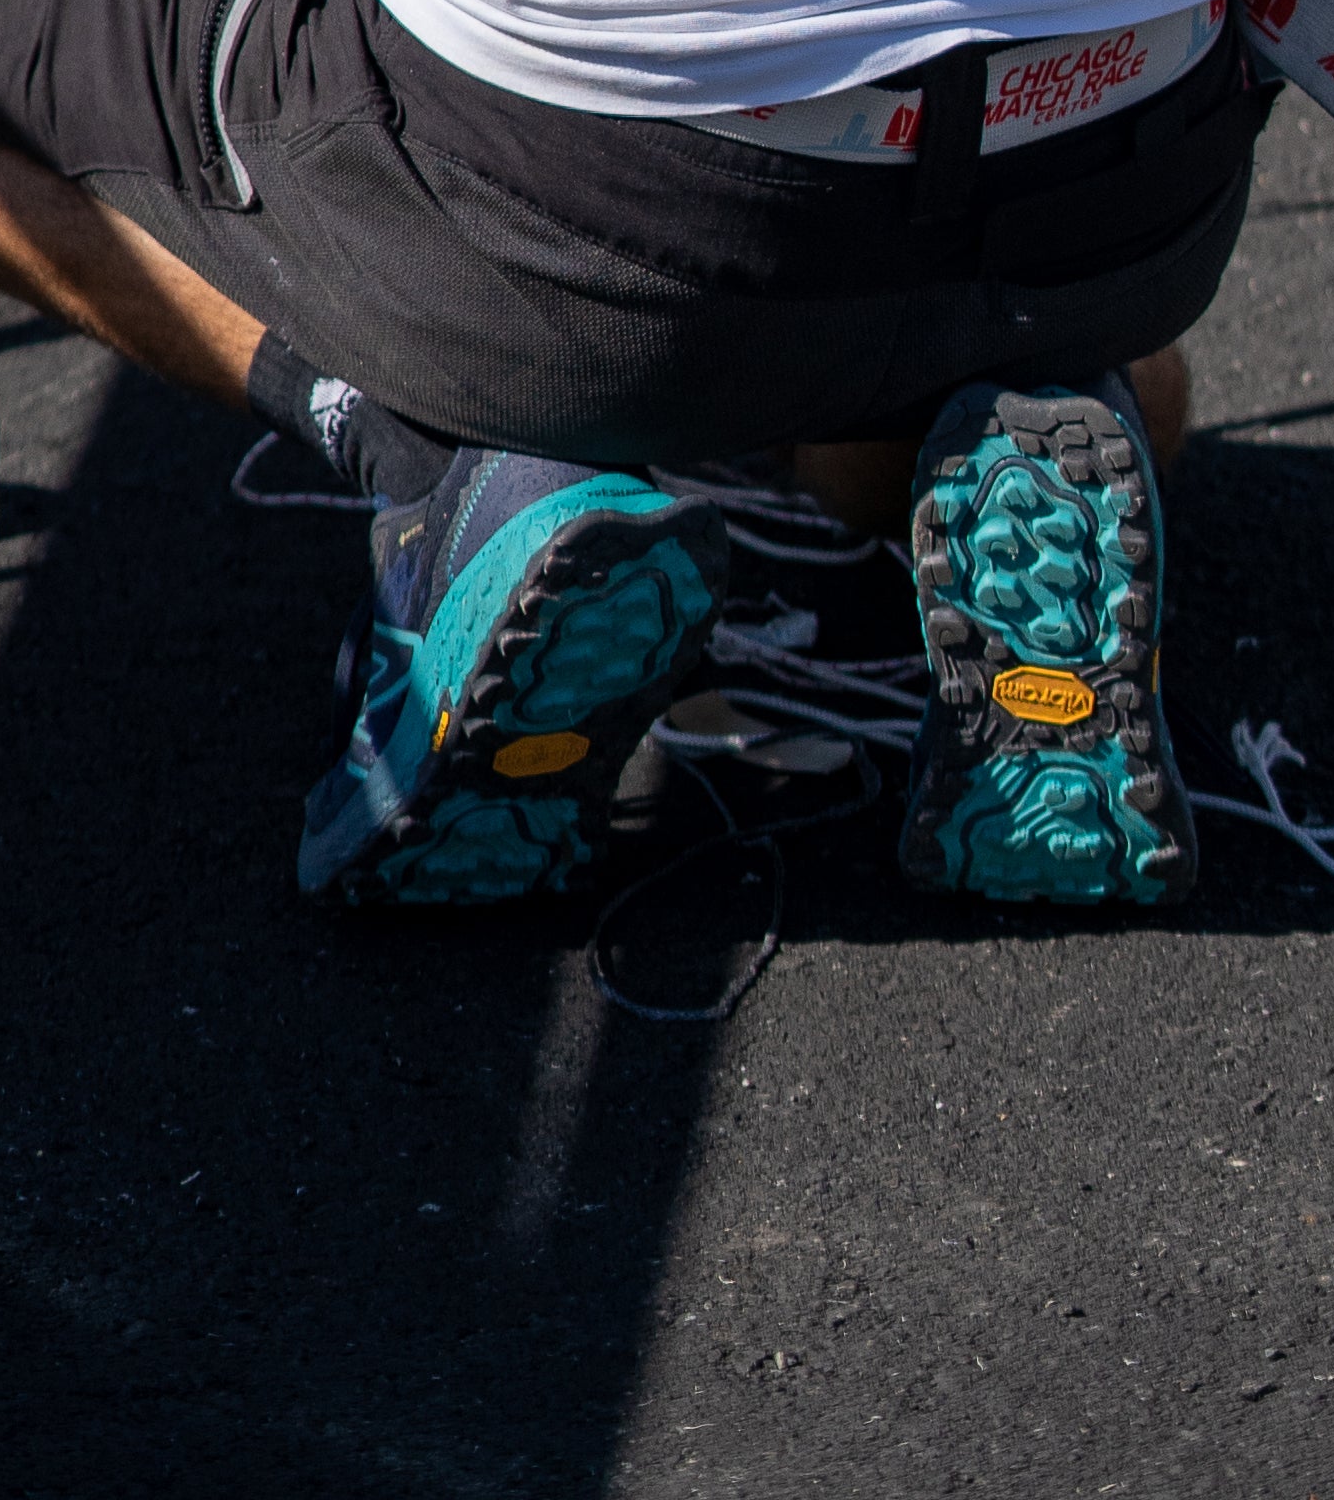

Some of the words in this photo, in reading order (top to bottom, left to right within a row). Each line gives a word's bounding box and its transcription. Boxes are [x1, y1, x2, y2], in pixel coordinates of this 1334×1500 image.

[984, 79, 1075, 127] MATCH
[1080, 48, 1148, 99] RACE
[999, 29, 1136, 97] CHICAGO
[1032, 90, 1103, 126] CENTER
